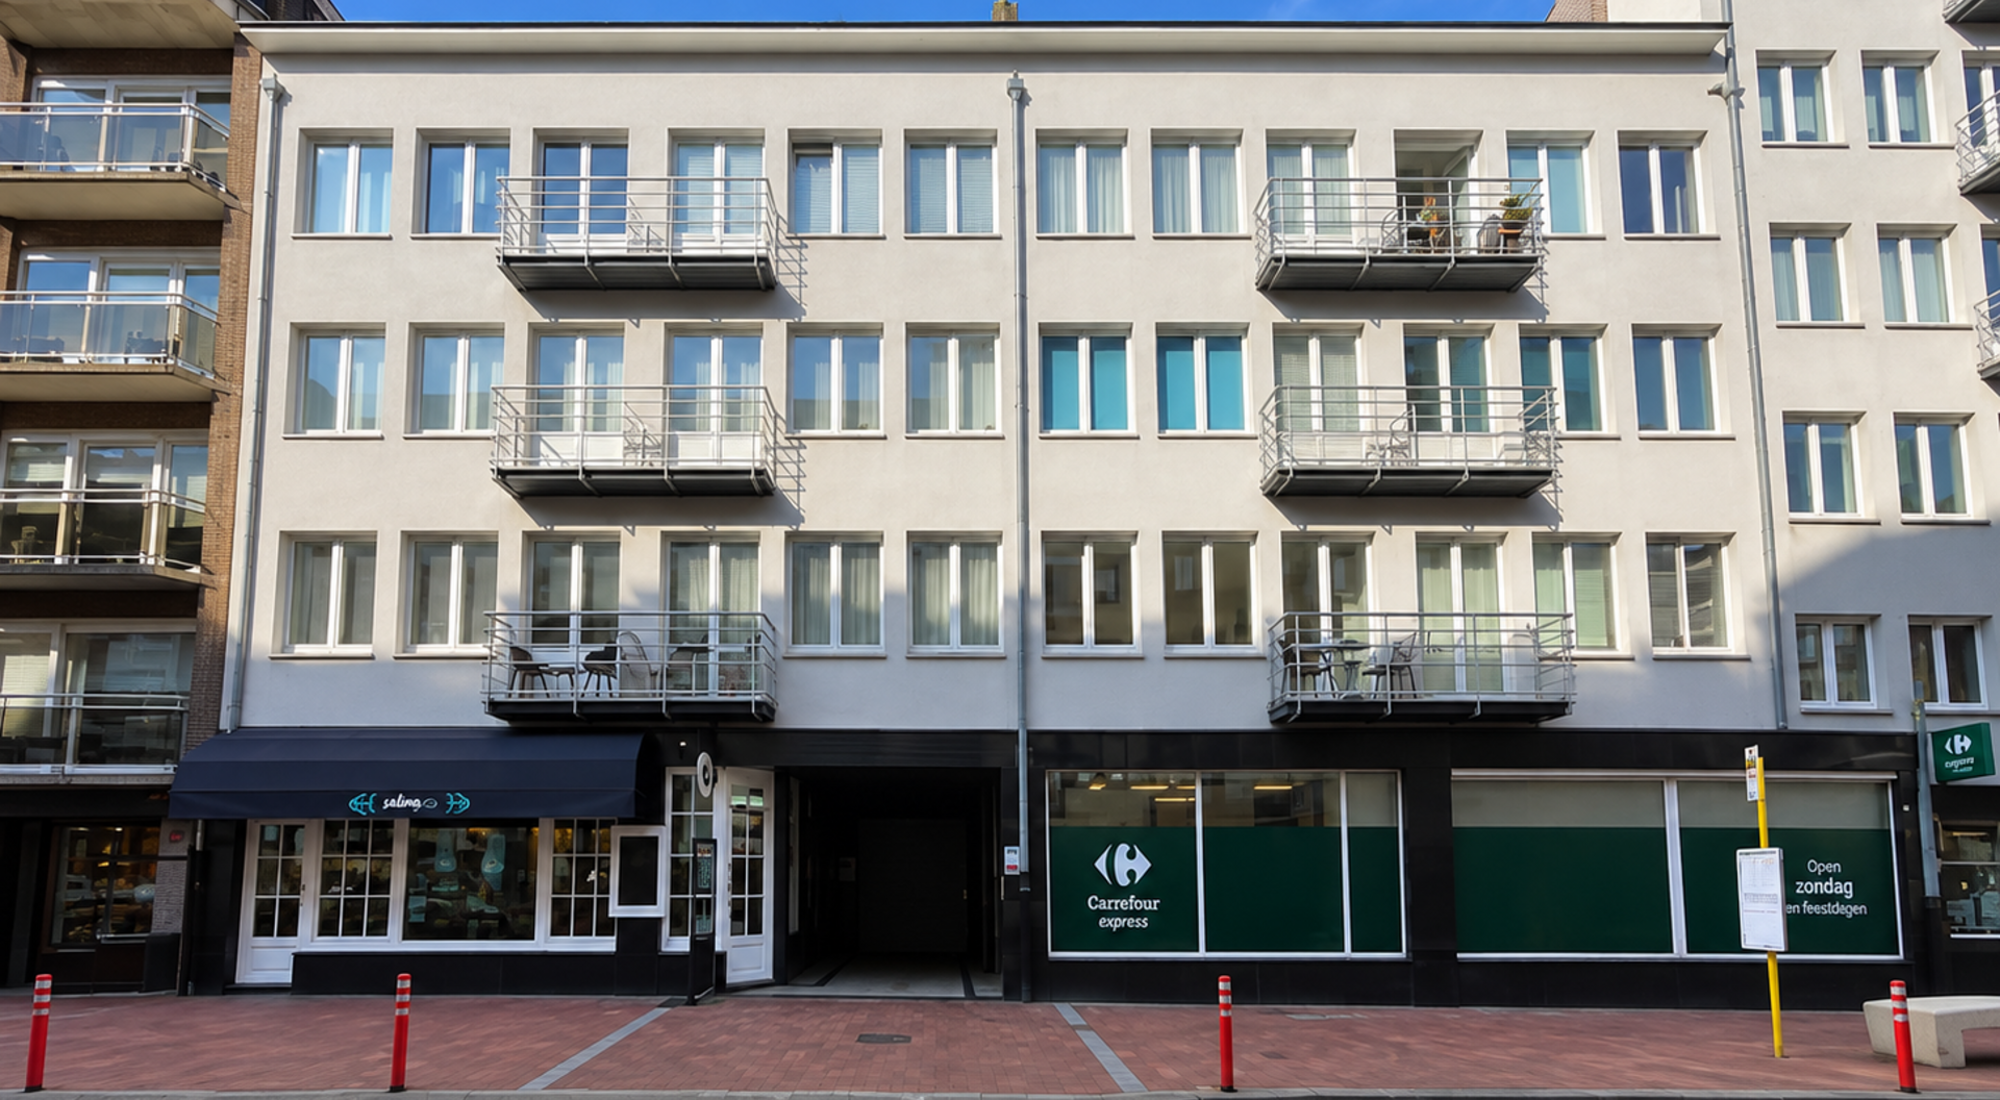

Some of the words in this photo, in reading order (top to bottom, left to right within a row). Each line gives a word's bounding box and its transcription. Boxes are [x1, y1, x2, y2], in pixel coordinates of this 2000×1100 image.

[1807, 859, 1841, 875] Open
[1795, 877, 1853, 899] zondag
[1087, 895, 1160, 910] Carrefour
[1098, 917, 1148, 931] express
